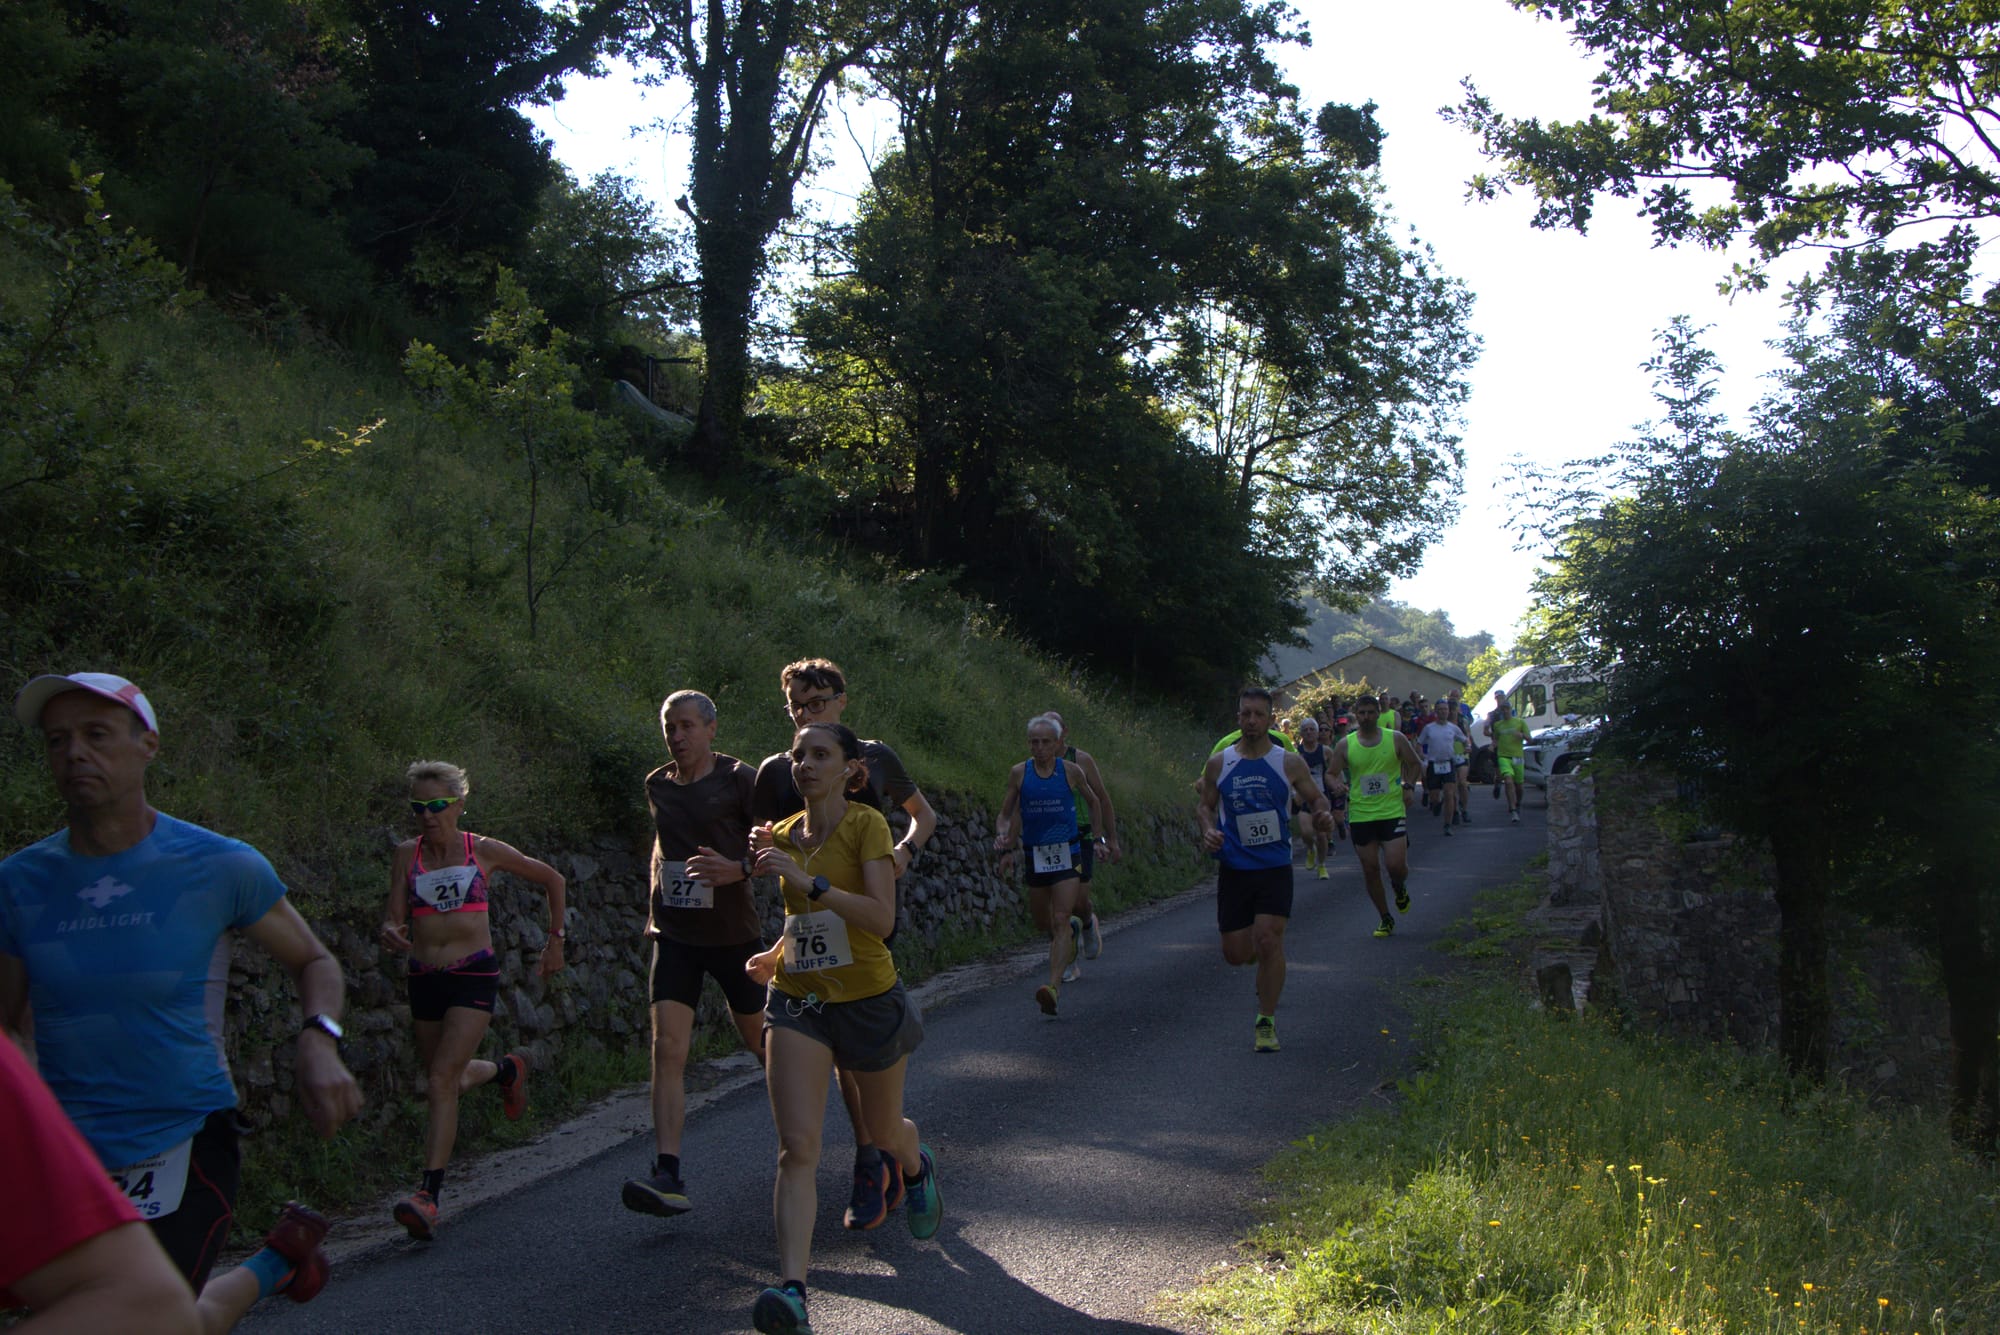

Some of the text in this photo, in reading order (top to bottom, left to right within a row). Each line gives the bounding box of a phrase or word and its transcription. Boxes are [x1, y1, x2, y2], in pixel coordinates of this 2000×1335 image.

[1368, 781, 1381, 790] 29
[1250, 825, 1268, 837] 30
[1045, 855, 1061, 865] 13
[435, 882, 460, 900] 21
[672, 880, 695, 896] 27
[669, 897, 702, 906] TUFF'S
[56, 912, 155, 934] RAIDLIGHT
[797, 935, 827, 957] 76
[795, 955, 838, 970] TUFF'S
